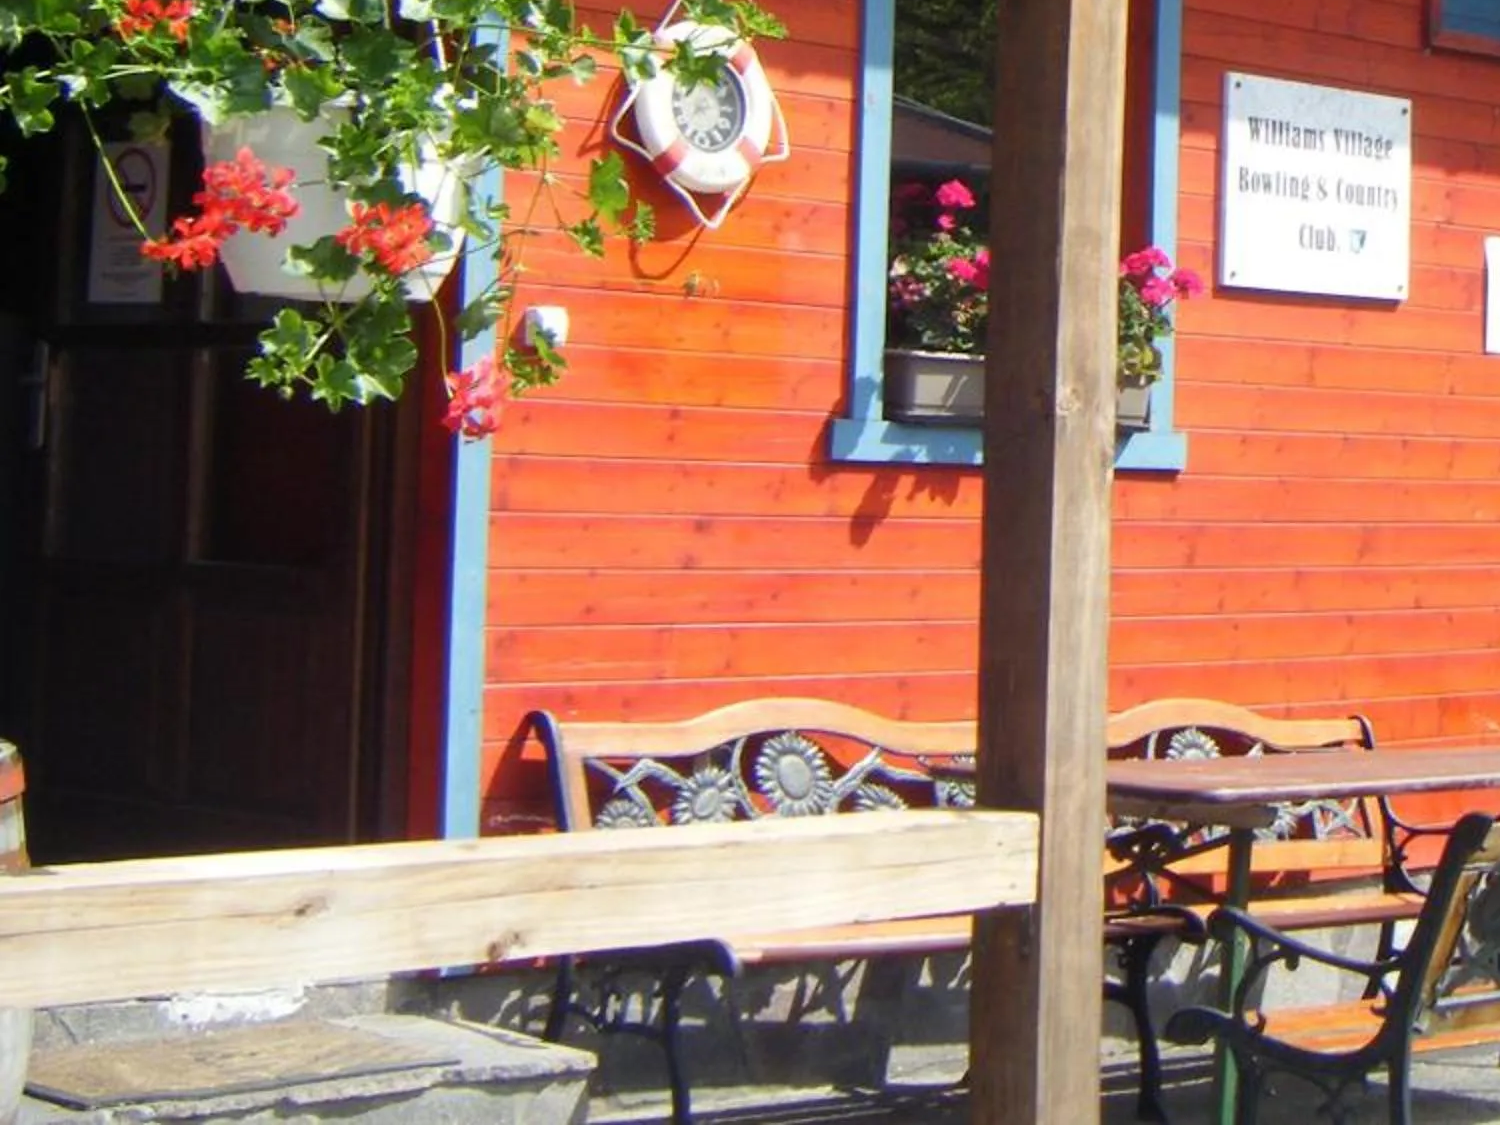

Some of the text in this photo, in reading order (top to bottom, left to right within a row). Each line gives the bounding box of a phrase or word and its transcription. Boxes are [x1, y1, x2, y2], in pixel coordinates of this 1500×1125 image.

[1247, 115, 1394, 161] Williams Village
[1238, 166, 1310, 202] Bowling
[1335, 178, 1399, 212] Country
